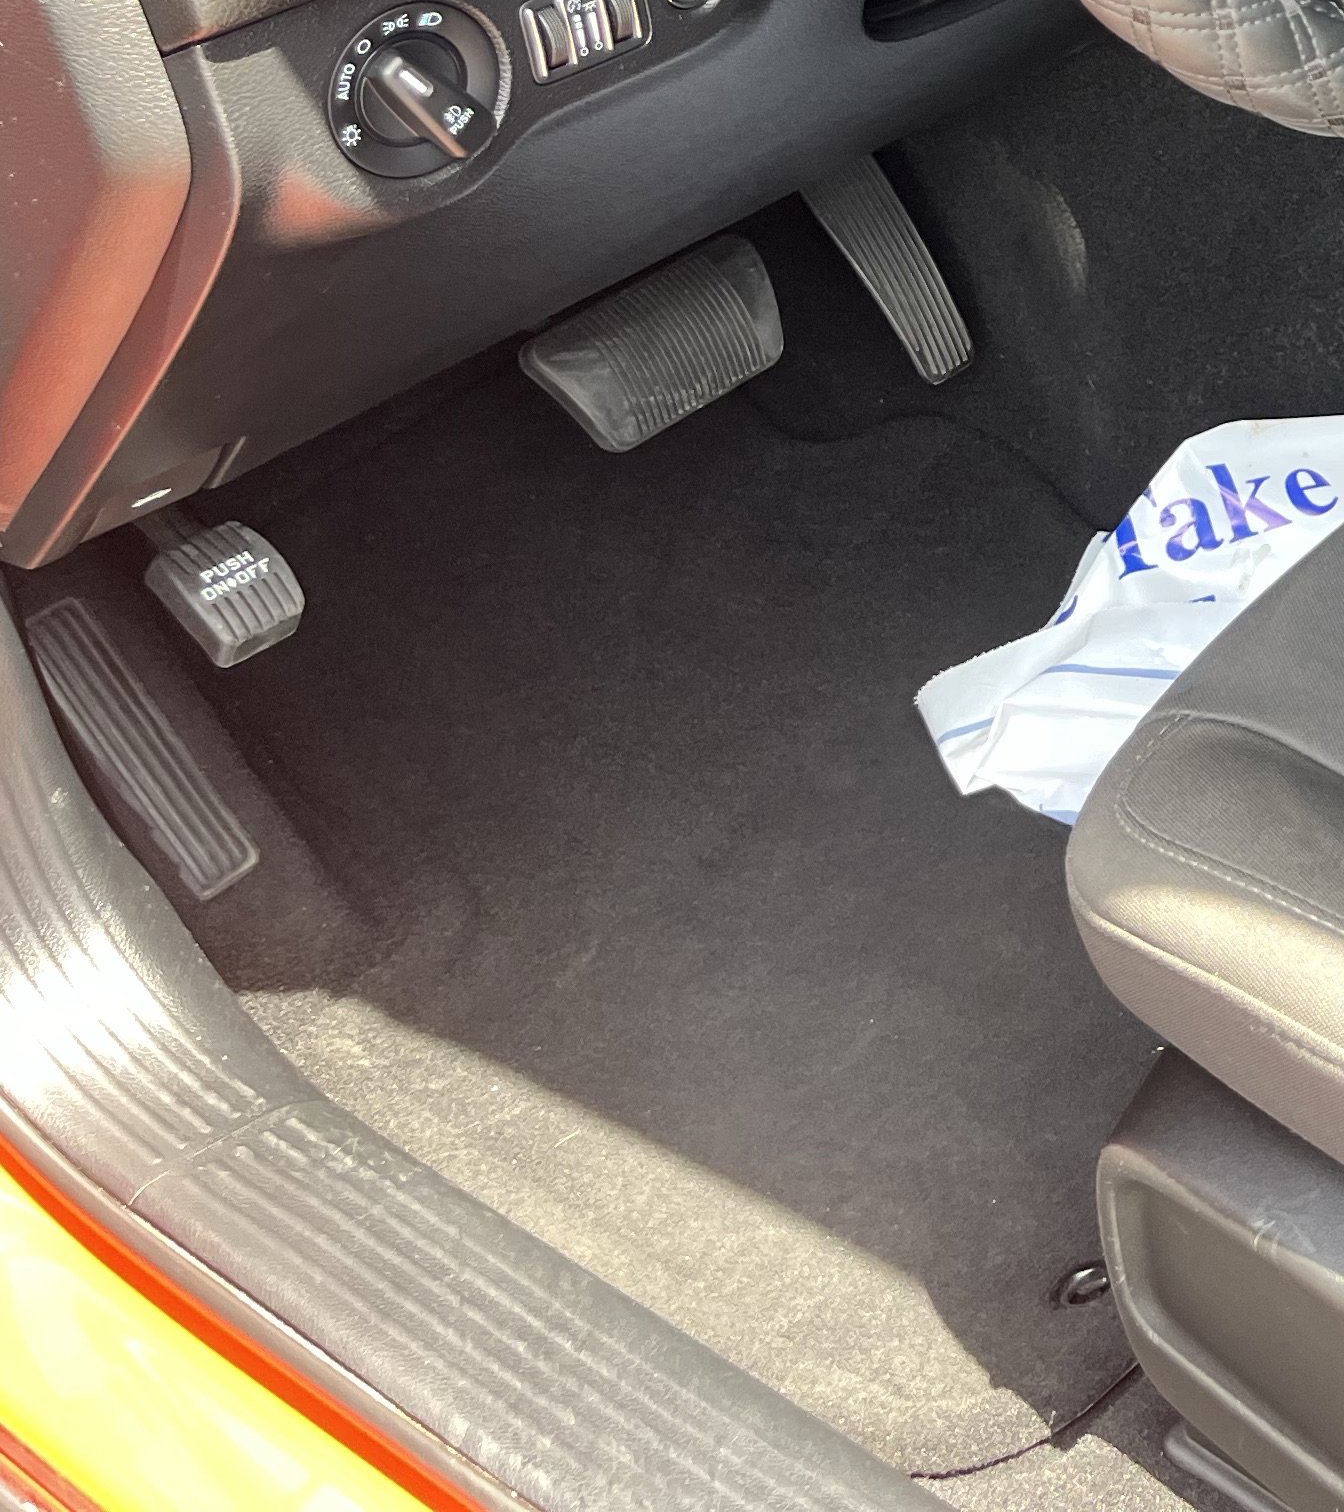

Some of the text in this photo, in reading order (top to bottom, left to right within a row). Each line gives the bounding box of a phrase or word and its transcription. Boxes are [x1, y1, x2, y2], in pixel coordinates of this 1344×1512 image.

[336, 63, 356, 100] AUTO
[449, 108, 474, 135] PUSH
[200, 550, 255, 583] PUSH
